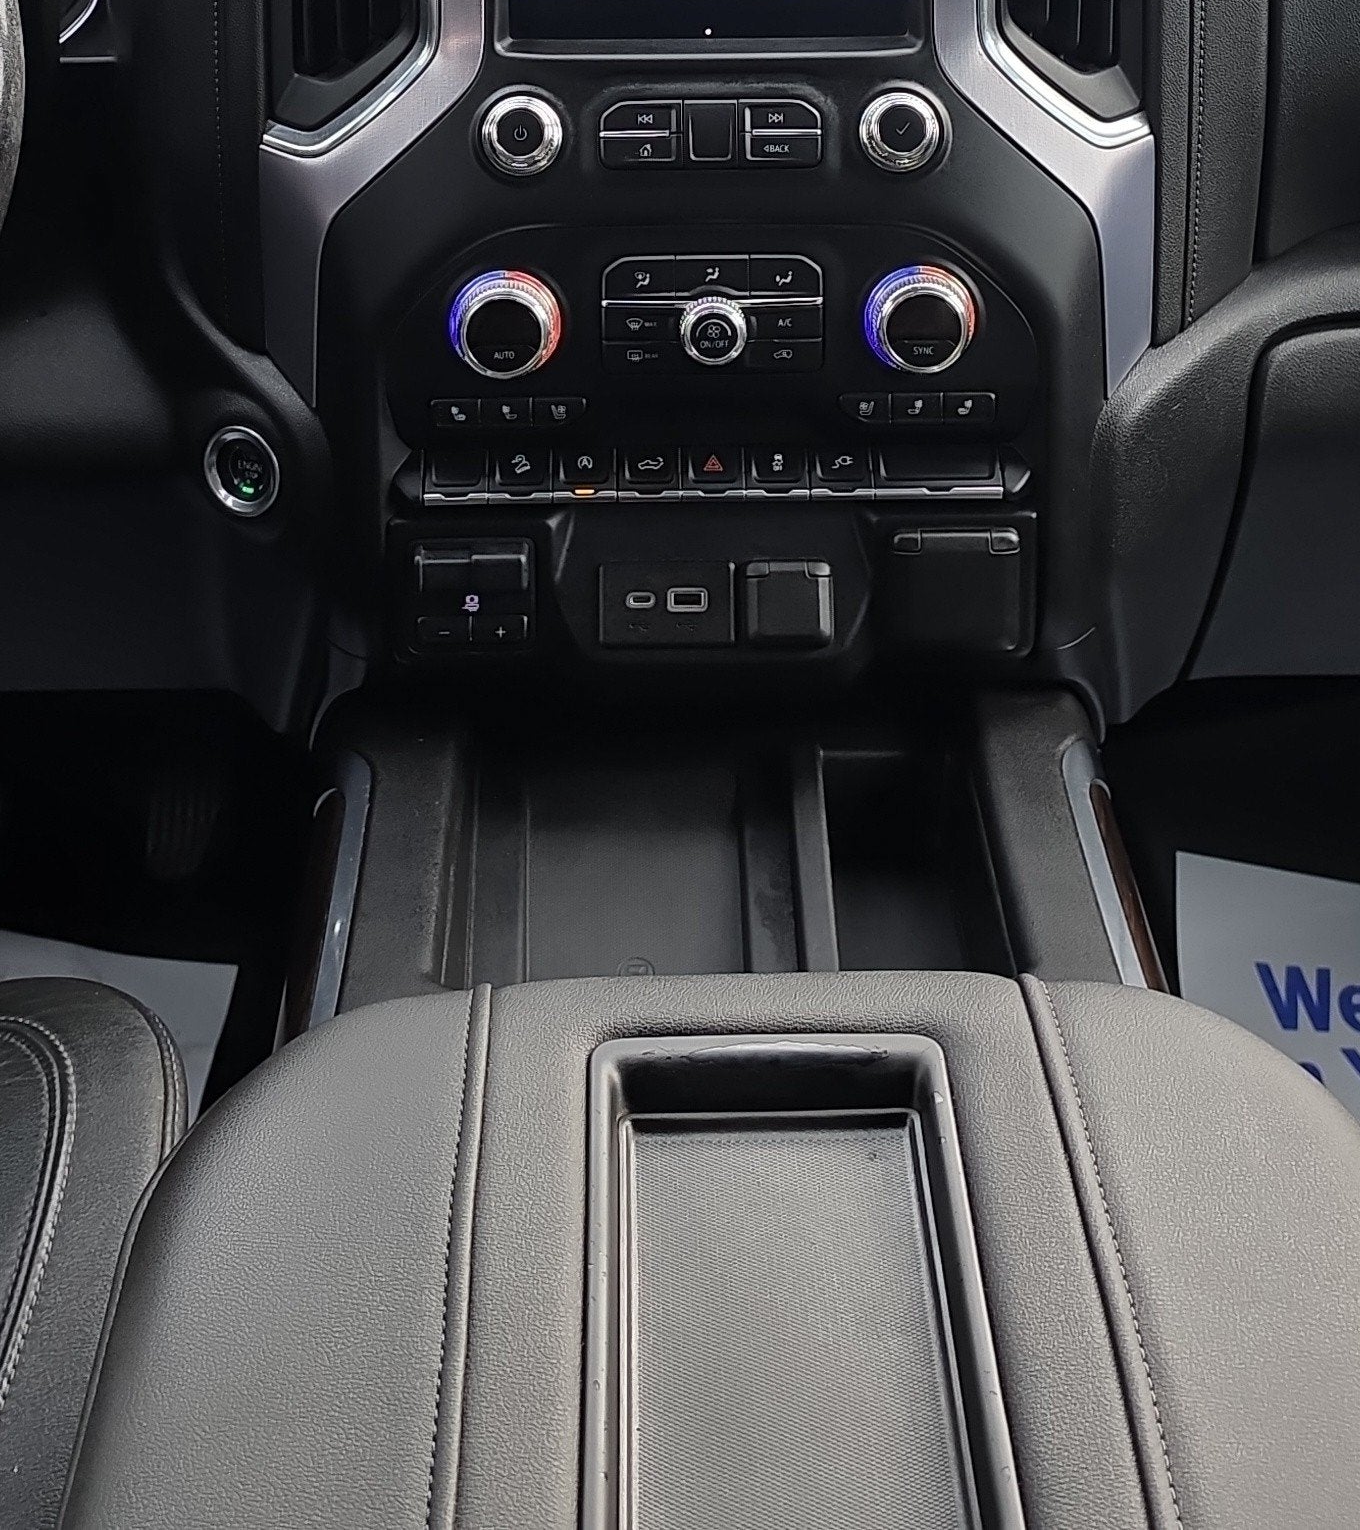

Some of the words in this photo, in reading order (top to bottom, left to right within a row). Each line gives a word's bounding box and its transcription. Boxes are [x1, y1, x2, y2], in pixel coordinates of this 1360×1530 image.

[769, 144, 790, 153] BACK
[777, 318, 793, 327] A/C
[699, 340, 730, 349] ON/OFF
[913, 346, 935, 355] SYNC
[493, 351, 516, 360] AUTO
